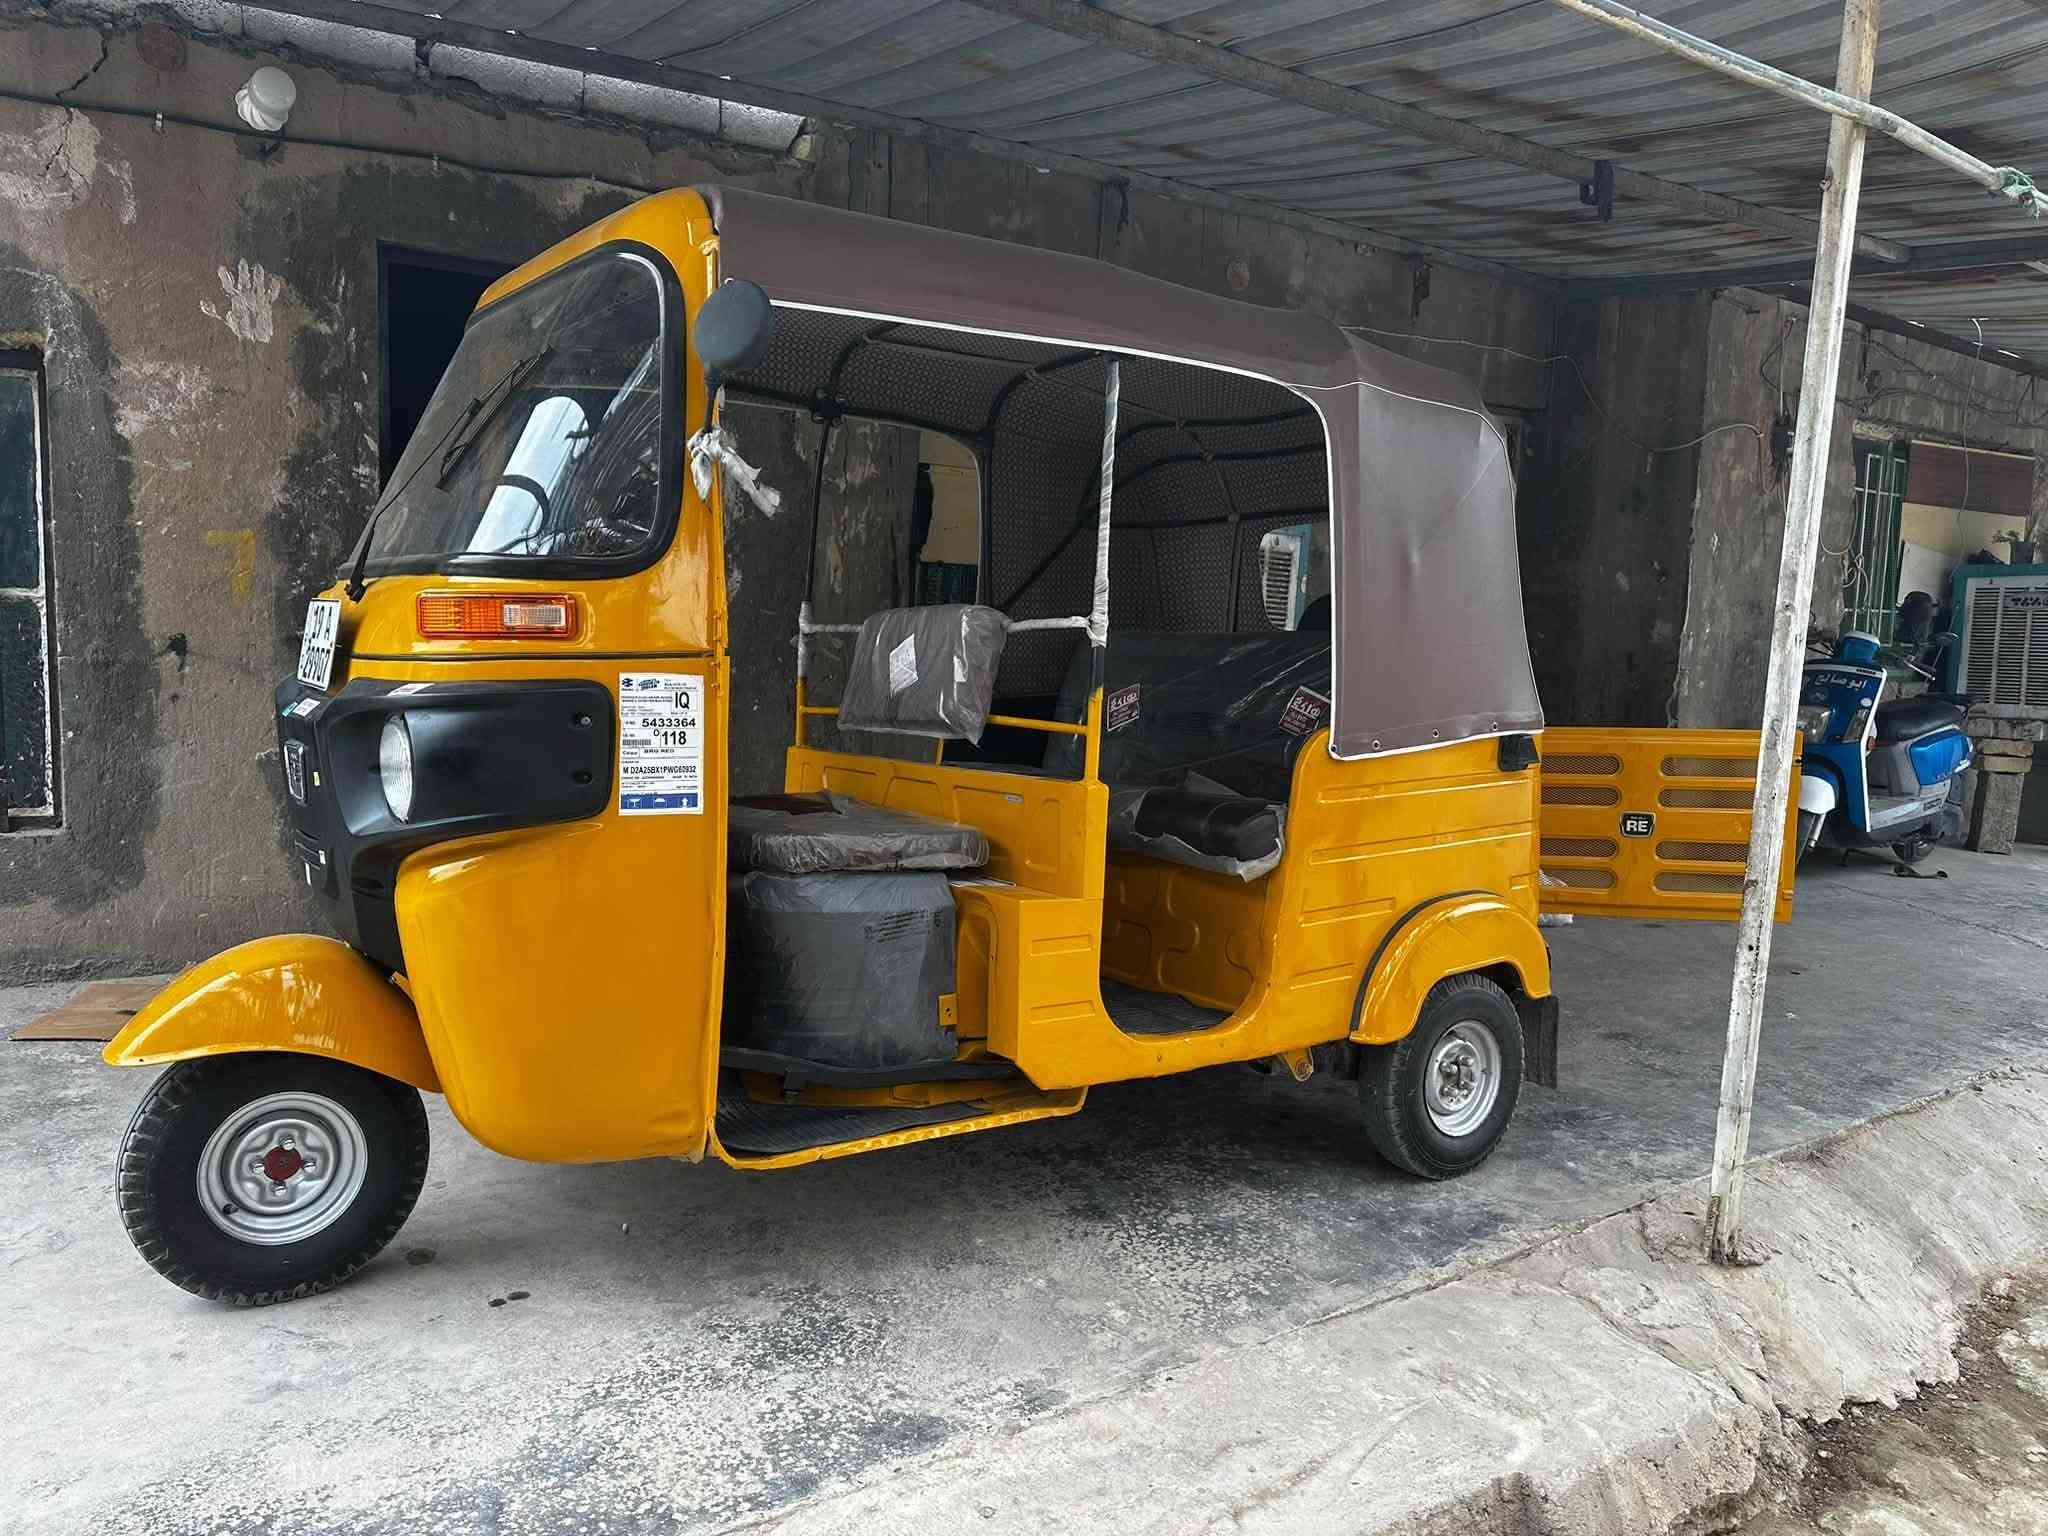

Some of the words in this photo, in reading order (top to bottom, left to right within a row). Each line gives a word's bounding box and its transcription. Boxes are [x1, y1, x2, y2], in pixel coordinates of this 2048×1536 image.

[324, 606, 333, 640] A
[675, 691, 690, 709] IQ
[641, 718, 697, 728] 5433364
[661, 730, 687, 745] 118
[1625, 819, 1649, 832] RE
